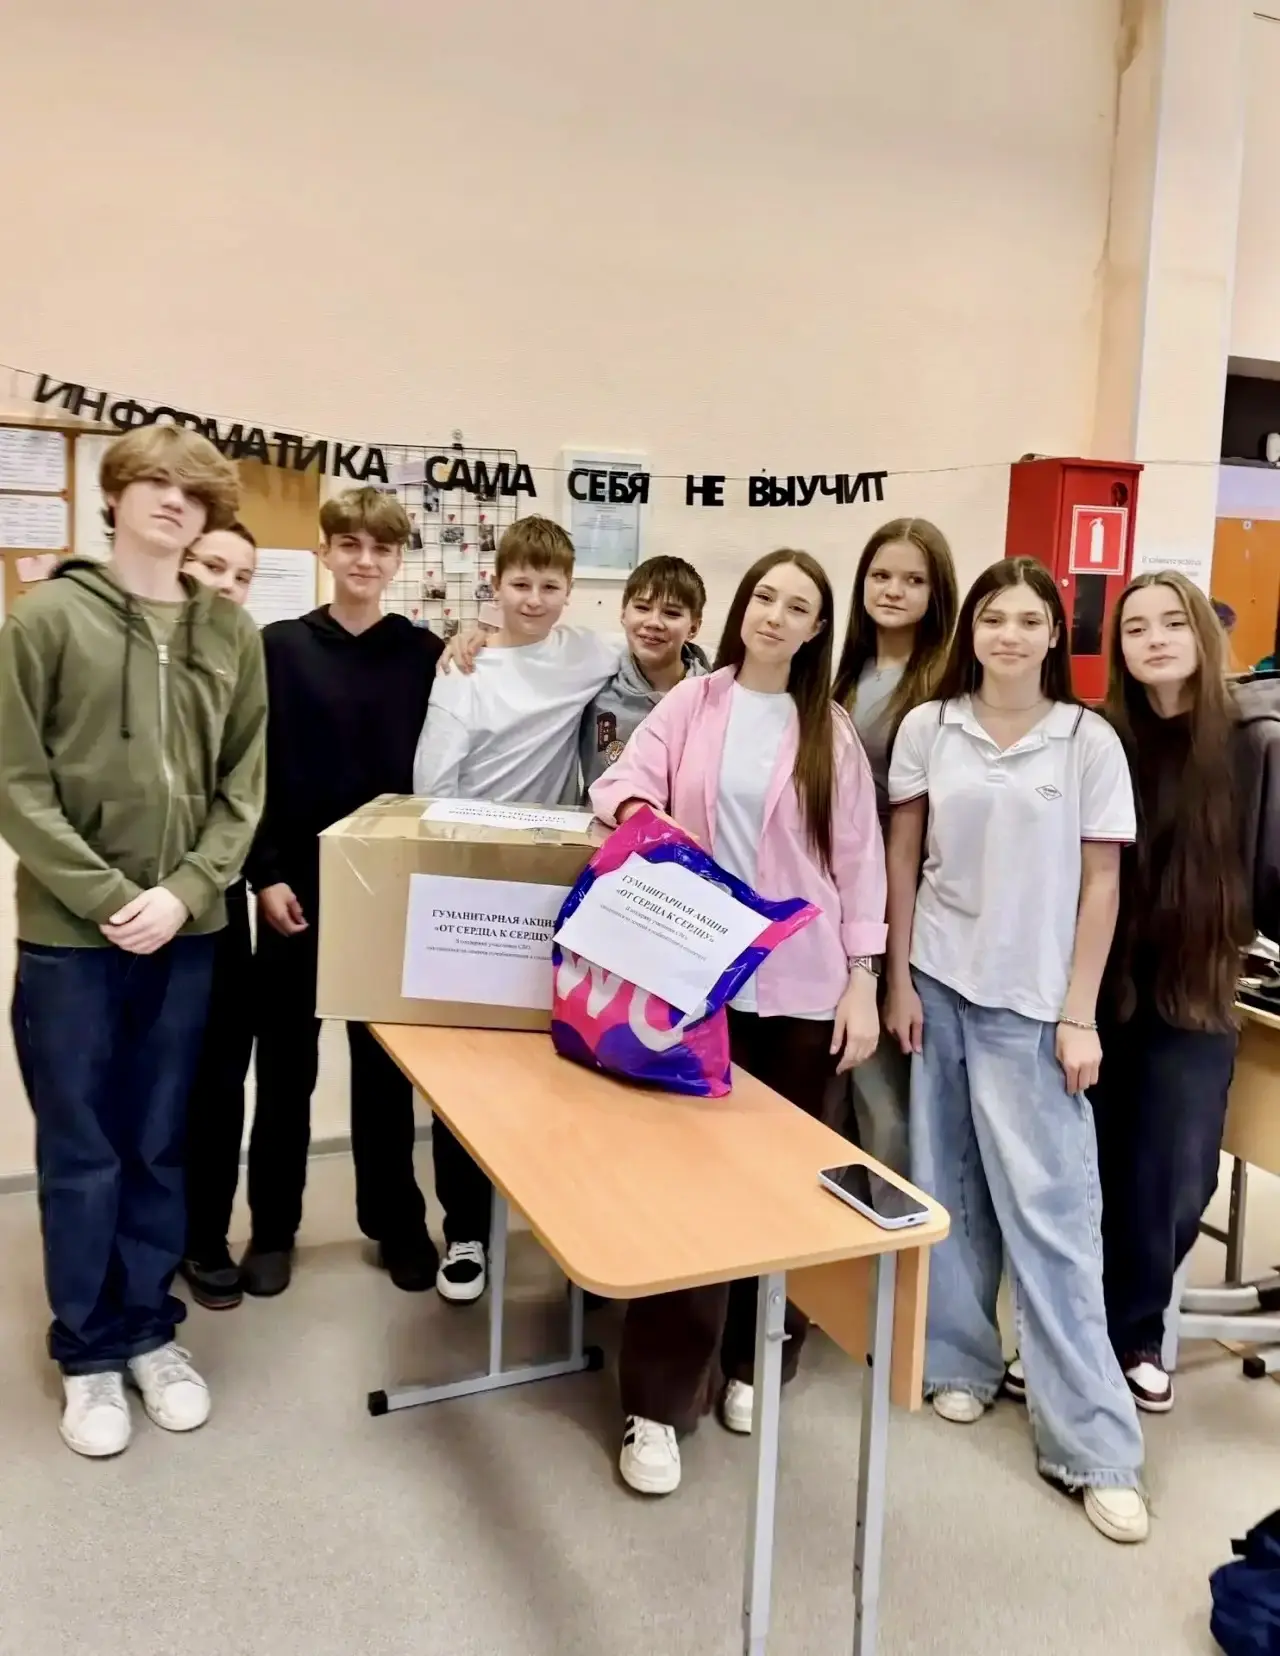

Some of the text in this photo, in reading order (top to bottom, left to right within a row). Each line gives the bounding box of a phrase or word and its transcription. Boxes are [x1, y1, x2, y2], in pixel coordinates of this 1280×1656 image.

[425, 455, 537, 497] САМА
[567, 467, 650, 504] СЕБЯ
[686, 474, 725, 506] НЕ
[749, 470, 888, 507] ВЫУЧИТ
[432, 909, 520, 924] ГУМАНИТАРНАЯ
[622, 874, 695, 915] ГУМАНИТАРНАЯ
[693, 913, 729, 935] АКЦИЯ
[632, 895, 666, 917] СЕРДЦА
[666, 911, 676, 921] К
[434, 923, 455, 933] «ОТ
[456, 925, 497, 938] СЕРДЦА
[499, 929, 507, 938] К
